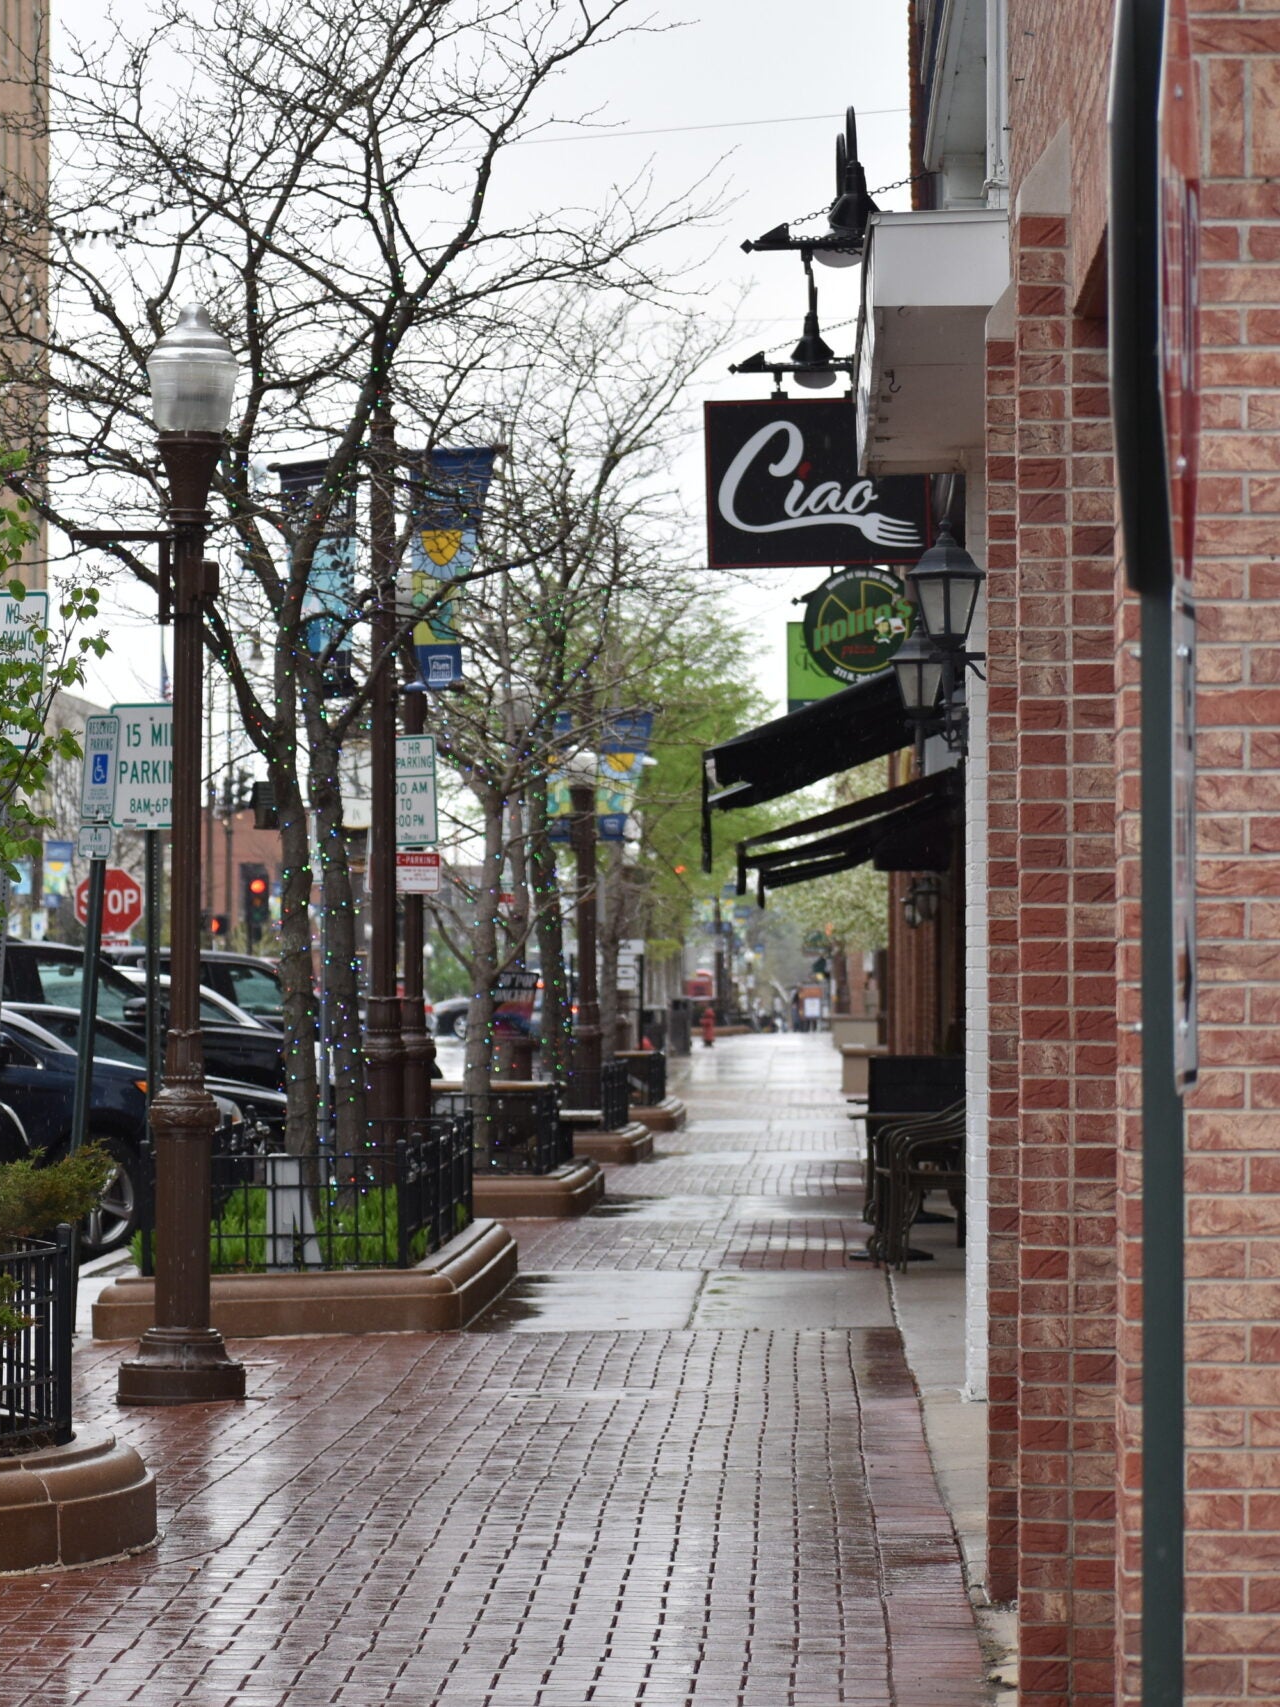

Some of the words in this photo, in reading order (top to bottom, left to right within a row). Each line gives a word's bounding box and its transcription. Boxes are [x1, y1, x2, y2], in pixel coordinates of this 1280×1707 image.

[718, 420, 879, 533] Ciao
[5, 603, 20, 625] NO
[88, 721, 116, 734] RESERVED
[126, 723, 141, 748] 15
[90, 738, 113, 751] PARKING
[408, 741, 421, 754] HR
[395, 755, 433, 769] PARKING
[119, 760, 173, 785] PARKI
[411, 781, 428, 794] AM
[129, 797, 172, 814] 8AM-6P
[400, 798, 412, 811] TO
[412, 814, 425, 827] PM
[80, 889, 139, 915] SOP
